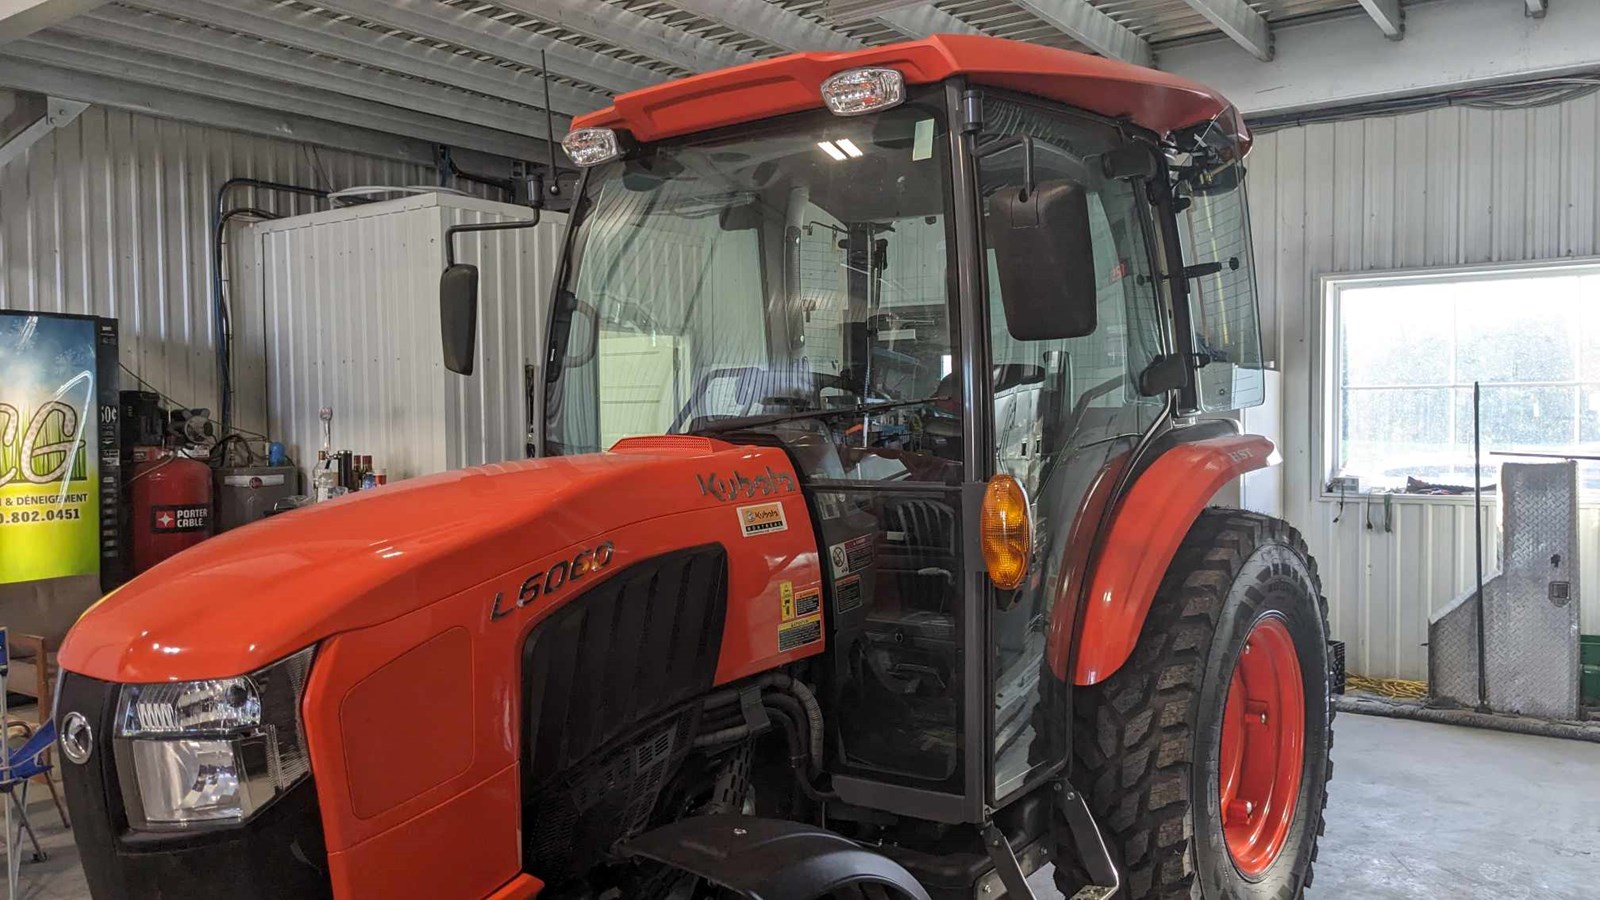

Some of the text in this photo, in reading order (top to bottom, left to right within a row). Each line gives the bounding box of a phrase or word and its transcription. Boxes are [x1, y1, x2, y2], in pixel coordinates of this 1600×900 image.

[0, 401, 86, 487] G
[1227, 447, 1254, 463] HST
[696, 466, 795, 501] Kubota
[5, 497, 13, 506] &
[16, 493, 88, 506] DÉNEIGEMENT
[176, 508, 208, 518] PORTER
[754, 509, 779, 519] Kubota
[176, 518, 204, 527] CABLE
[490, 540, 614, 622] L6060
